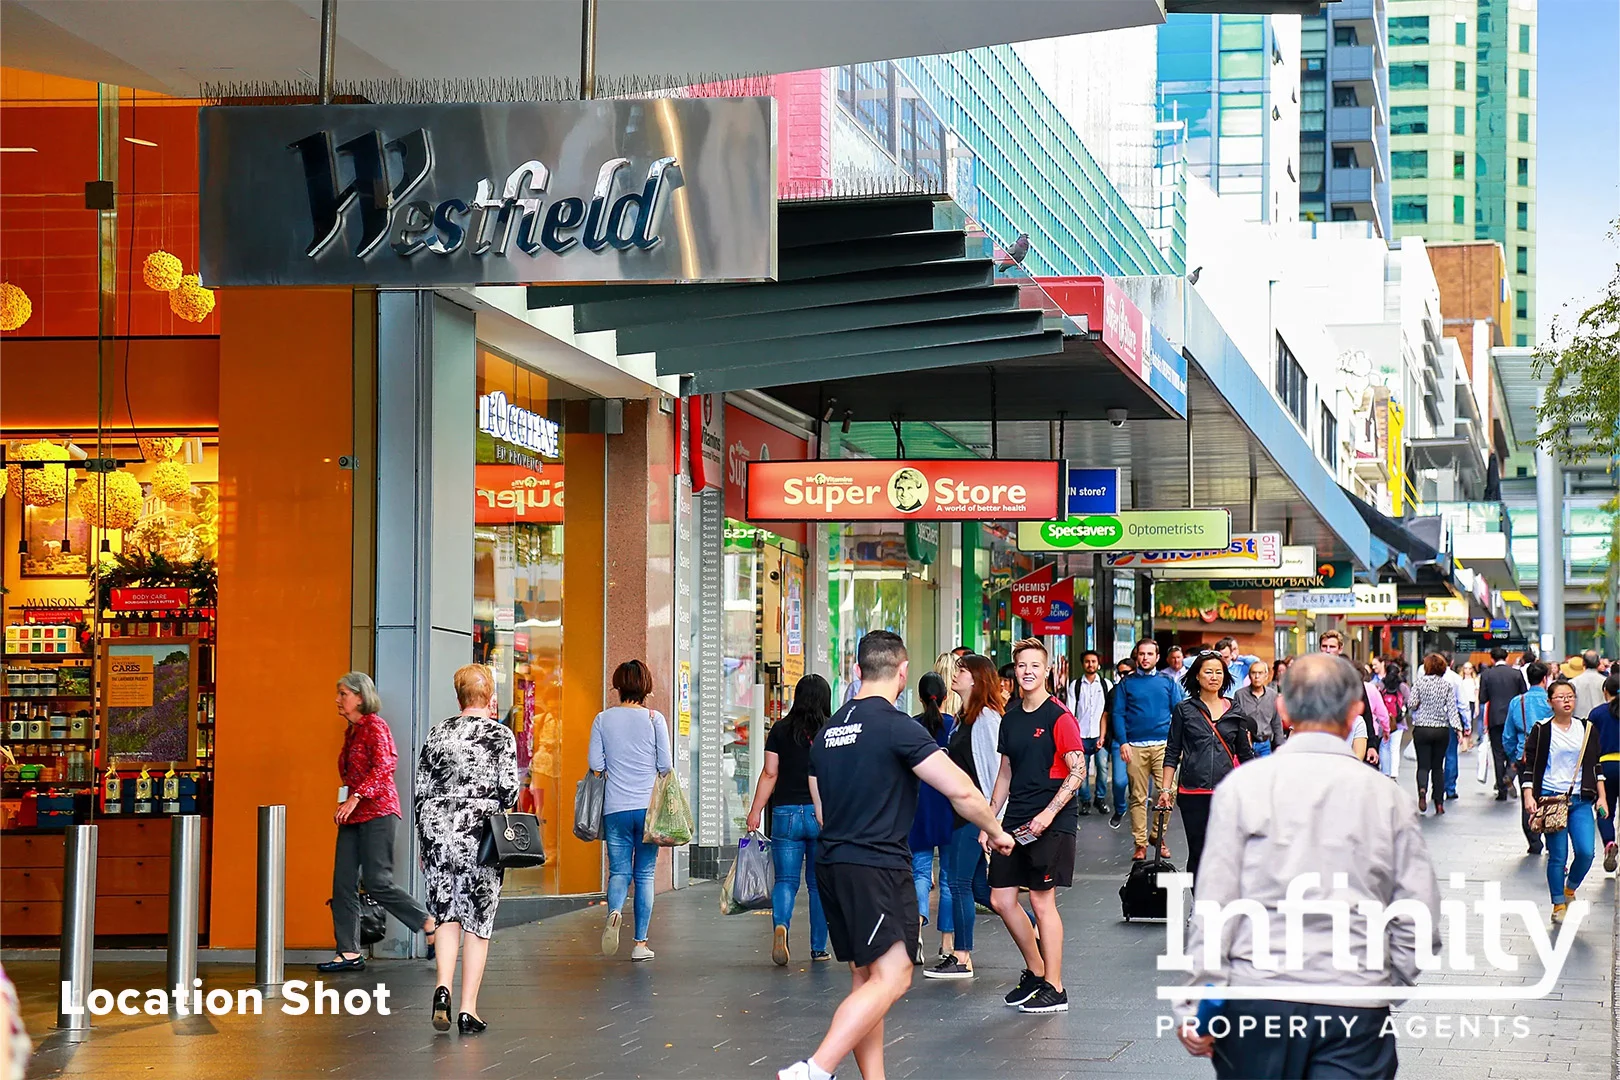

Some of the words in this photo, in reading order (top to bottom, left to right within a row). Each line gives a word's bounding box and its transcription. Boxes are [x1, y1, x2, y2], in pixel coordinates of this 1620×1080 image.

[286, 127, 684, 258] Westfield
[729, 444, 747, 499] Sup
[783, 478, 881, 513] Super
[934, 478, 1026, 504] Store
[1079, 487, 1107, 496] store?
[944, 504, 966, 512] world
[967, 504, 976, 512] of
[977, 504, 1001, 512] better
[1002, 504, 1027, 512] health
[1049, 524, 1116, 539] Specsavers
[1128, 523, 1205, 537] Optometrists
[1012, 582, 1051, 592] CHEMIST
[1290, 575, 1325, 587] BANK
[27, 597, 77, 607] MAISON
[1019, 595, 1046, 604] OPEN
[1219, 603, 1269, 621] Coffees
[111, 664, 141, 672] CARES
[824, 723, 863, 739] PERSONAL
[825, 733, 857, 748] TRAINER
